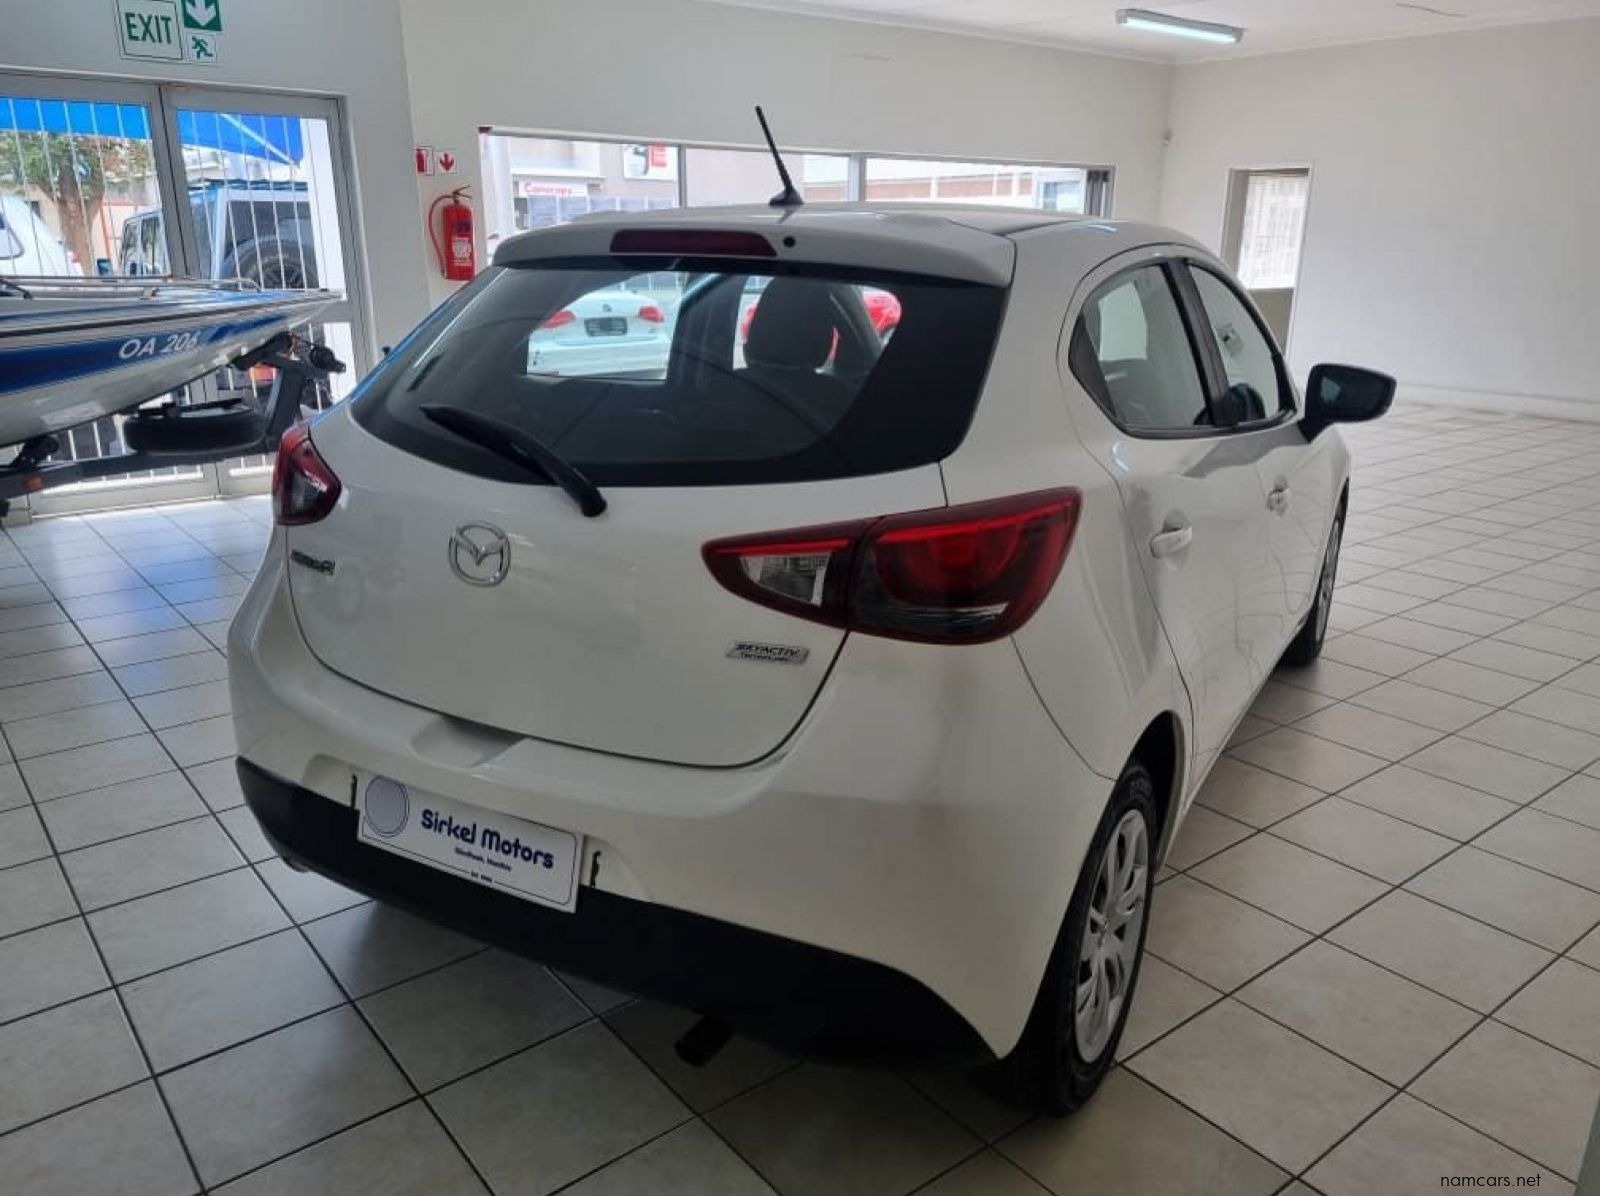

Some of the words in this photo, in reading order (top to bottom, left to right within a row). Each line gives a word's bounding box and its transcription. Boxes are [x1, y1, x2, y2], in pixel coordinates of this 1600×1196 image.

[125, 12, 172, 44] EXIT
[119, 337, 157, 359] OA
[421, 808, 477, 844] Sirkel
[481, 828, 555, 869] Motors
